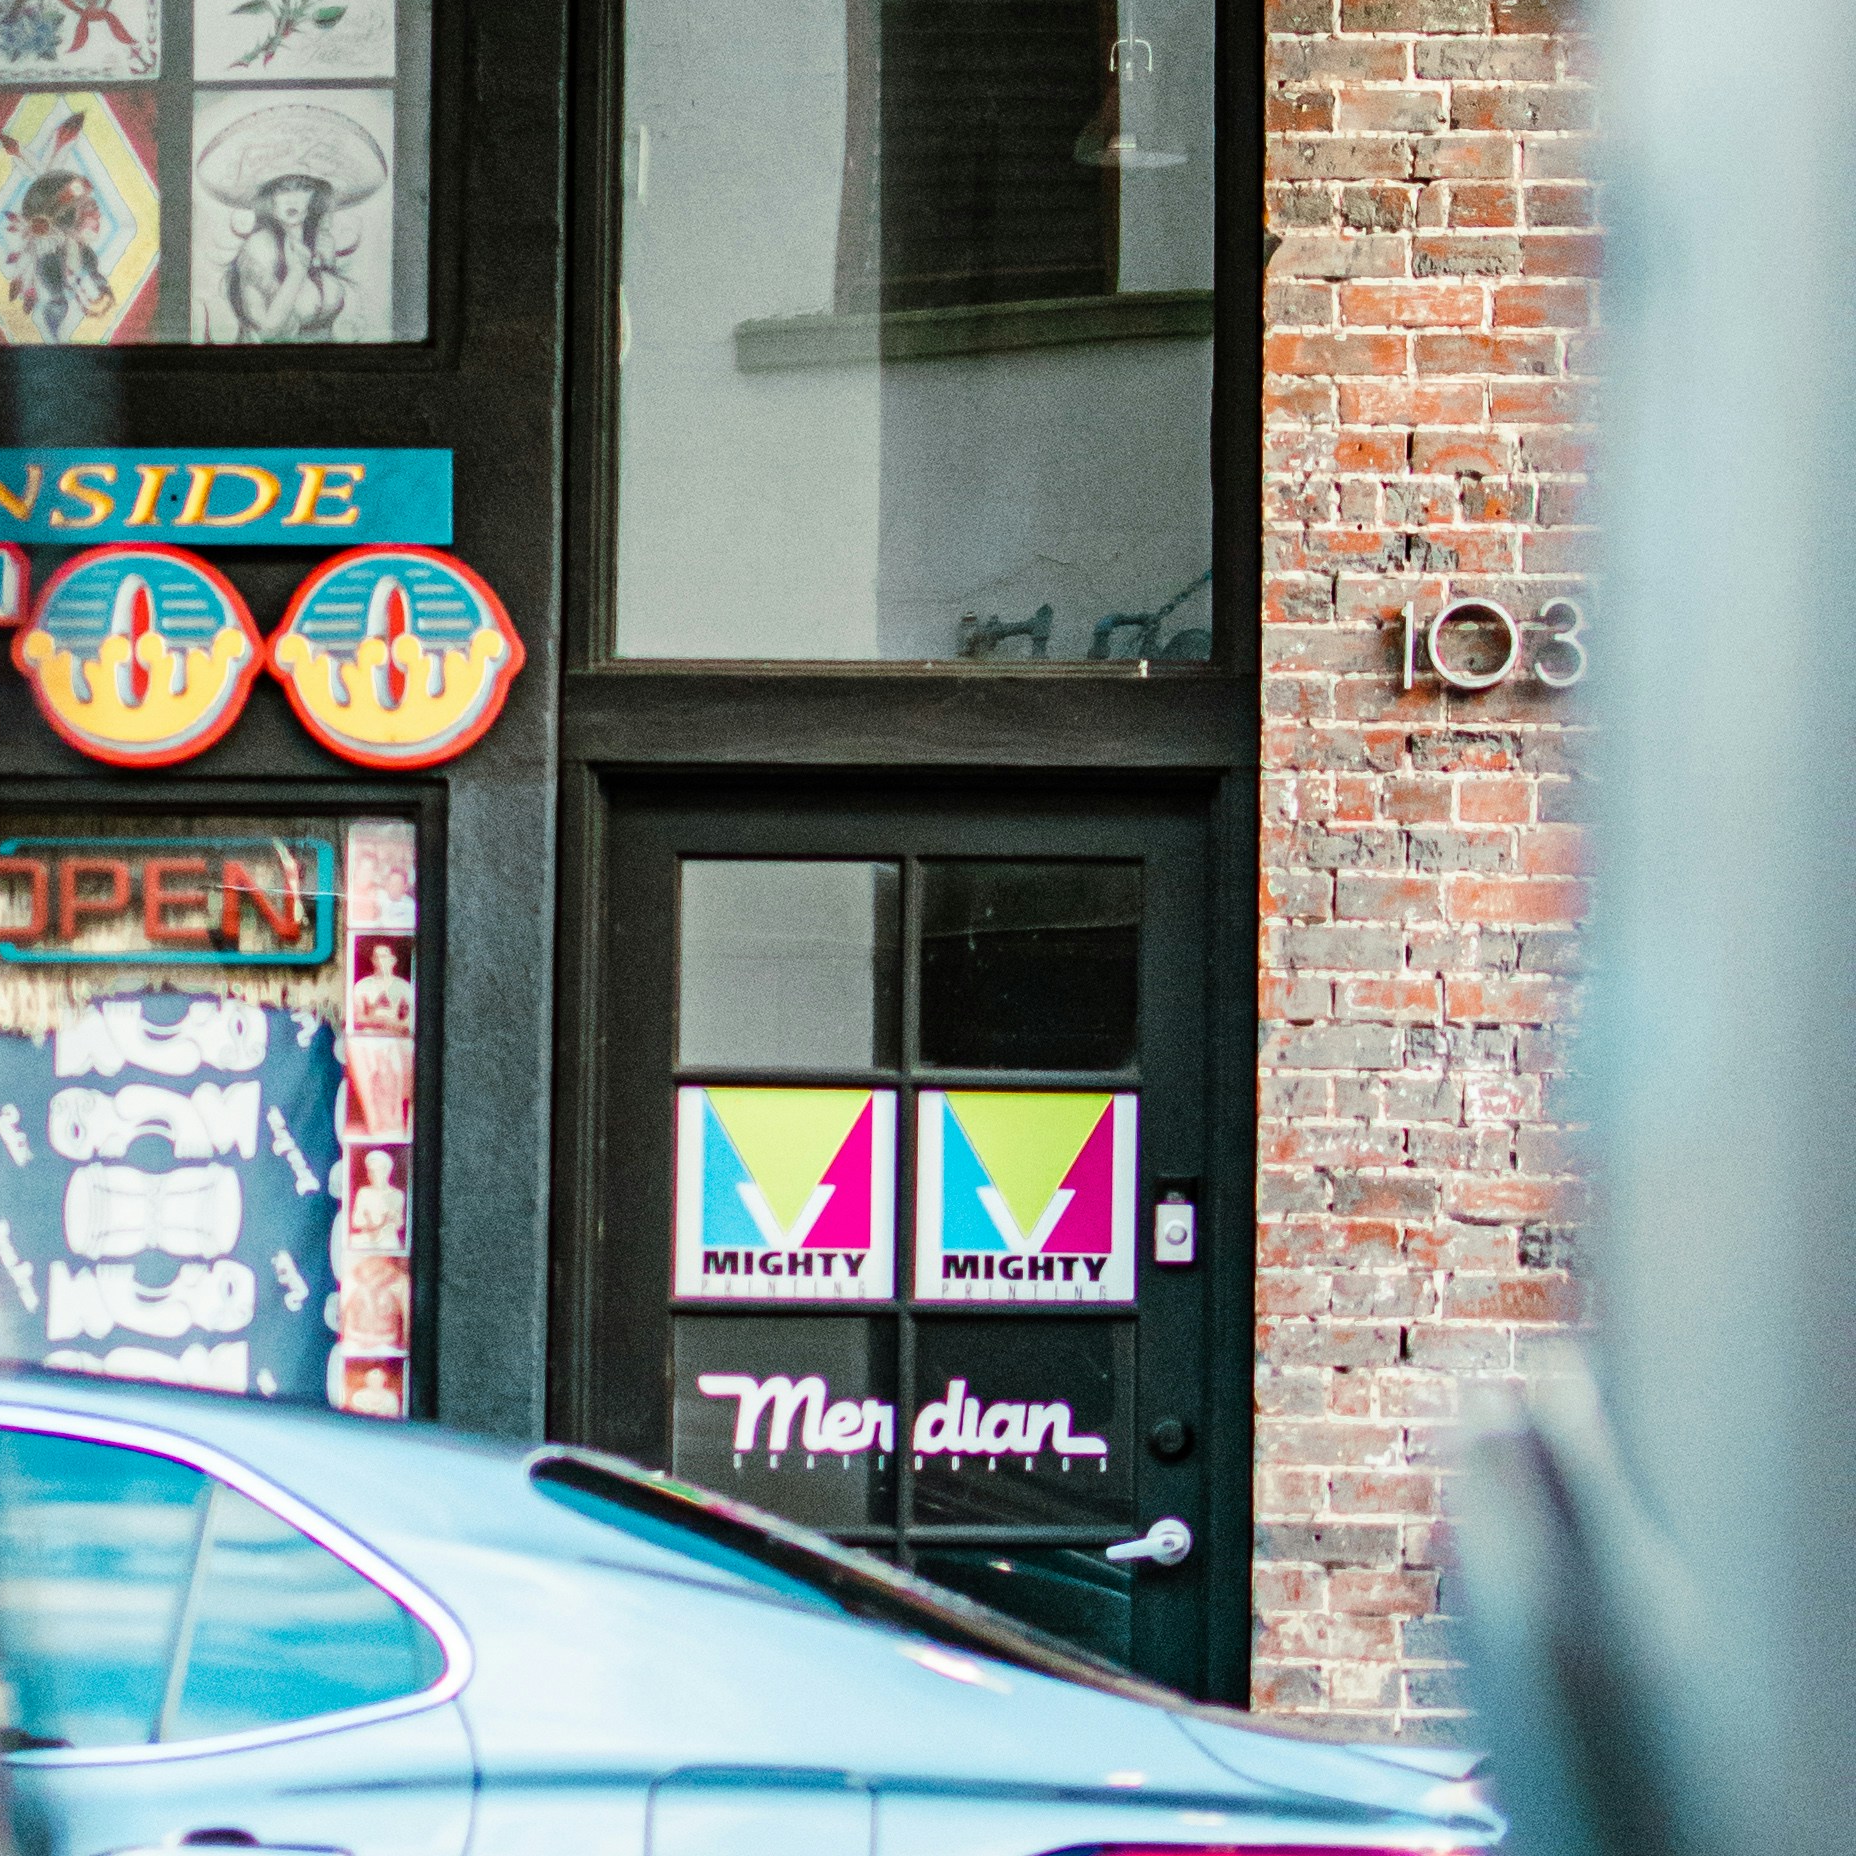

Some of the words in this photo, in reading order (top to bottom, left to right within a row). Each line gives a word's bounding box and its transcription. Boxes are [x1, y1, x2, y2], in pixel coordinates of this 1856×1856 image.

[1401, 596, 1587, 690] 103
[703, 1251, 866, 1277] MIGHTY
[942, 1255, 1108, 1283] MIGHTY
[700, 1279, 866, 1297] PRINTING
[941, 1282, 1108, 1300] PRINTING
[698, 1374, 1108, 1454] Merdian
